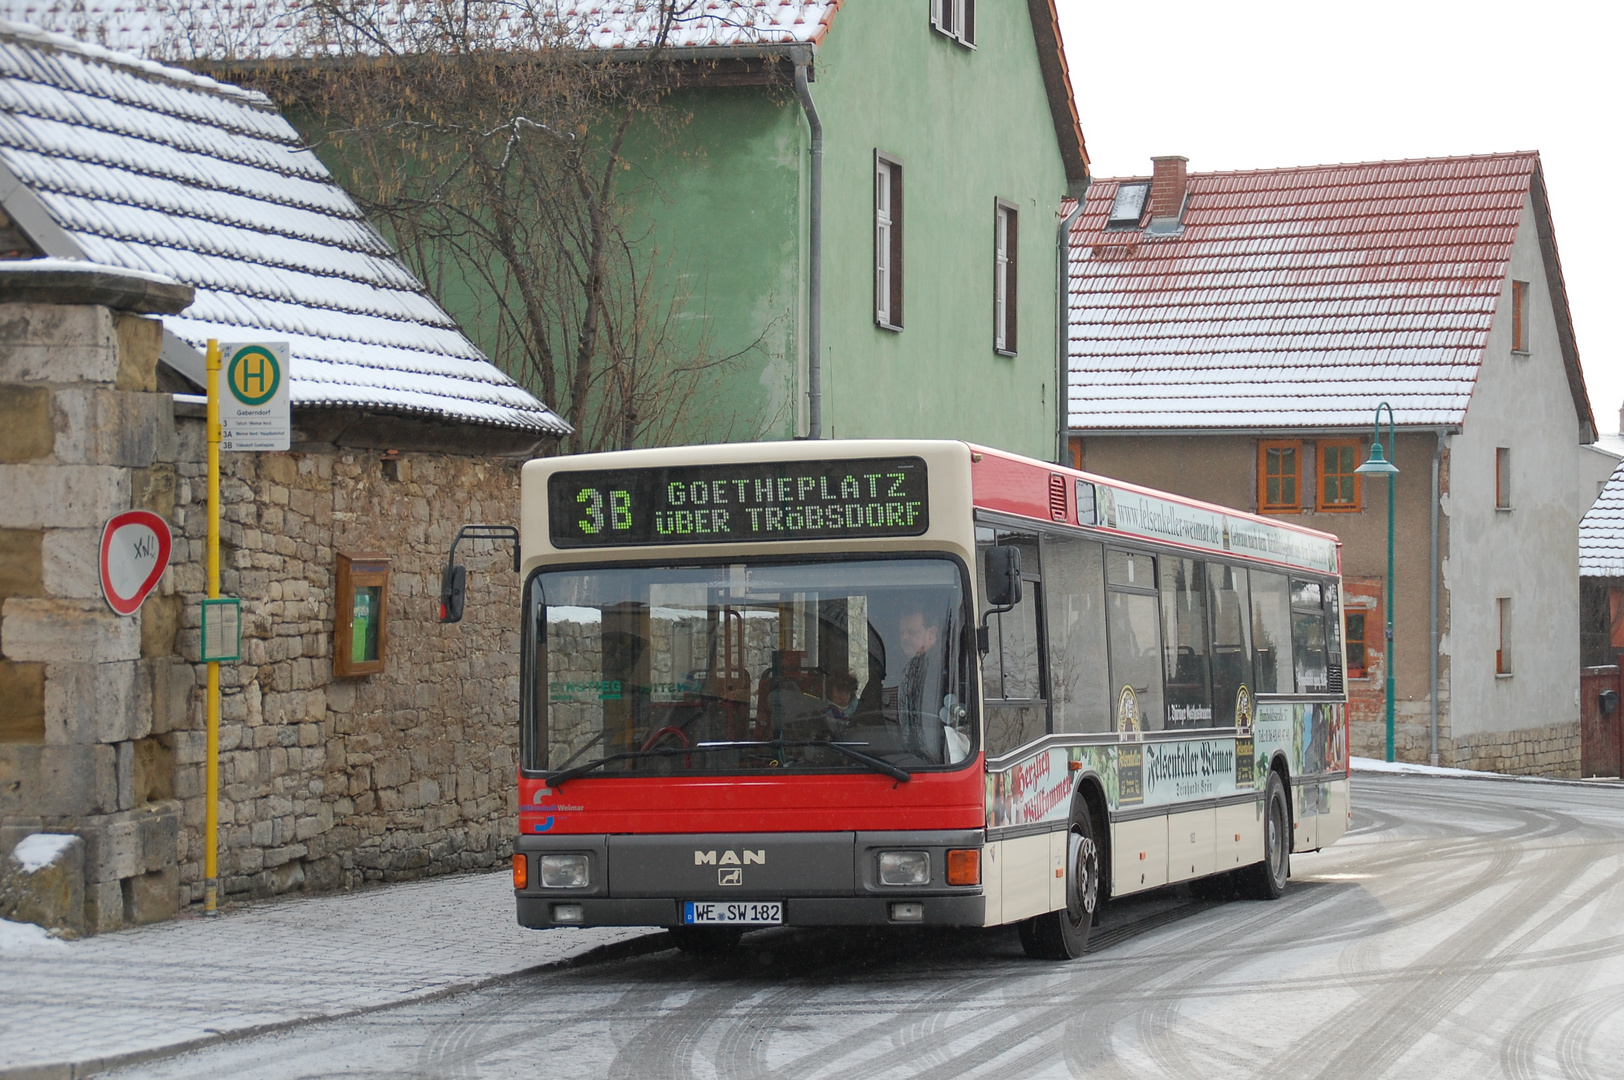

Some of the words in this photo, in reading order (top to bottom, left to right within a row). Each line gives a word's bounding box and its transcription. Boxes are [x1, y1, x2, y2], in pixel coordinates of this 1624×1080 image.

[222, 441, 233, 449] 3B
[667, 472, 907, 506] GOETHEPLATZ
[576, 487, 634, 535] 3B
[1117, 497, 1219, 545] www.felsenkeller-weimar.de
[550, 680, 622, 693] EINSTIEG
[1017, 750, 1050, 802] Herzlich
[1146, 742, 1198, 794] Felsenkeller
[1200, 741, 1233, 777] Weimar
[557, 804, 584, 812] Weimar
[1023, 774, 1072, 822] Willkommen
[694, 849, 766, 866] MAN
[695, 904, 716, 921] WE
[727, 904, 747, 921] SW
[750, 904, 780, 921] 182
